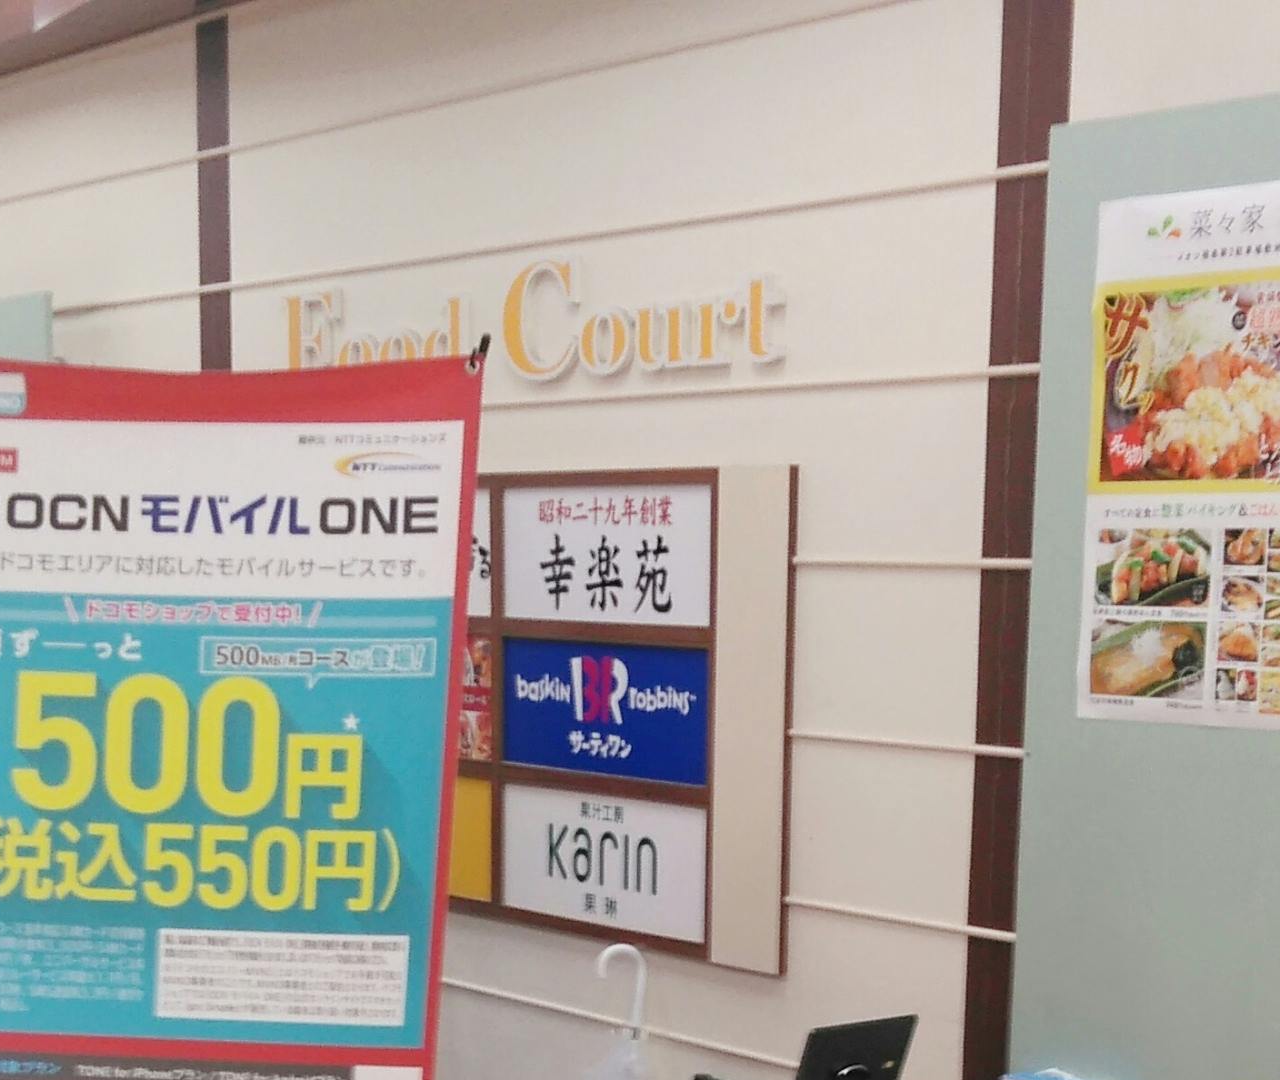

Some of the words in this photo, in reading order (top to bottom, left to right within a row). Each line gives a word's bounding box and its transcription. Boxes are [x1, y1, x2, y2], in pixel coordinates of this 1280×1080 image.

[503, 258, 784, 378] Court
[6, 492, 129, 532] OCN
[141, 494, 310, 535] モバイル
[320, 497, 439, 535] ONE
[538, 497, 674, 528] 昭和二十九年創業
[539, 533, 673, 614] 幸楽苑
[516, 673, 571, 703] baskin
[629, 685, 690, 716] robbins
[11, 669, 363, 820] 500円
[568, 730, 632, 758] サーティワン
